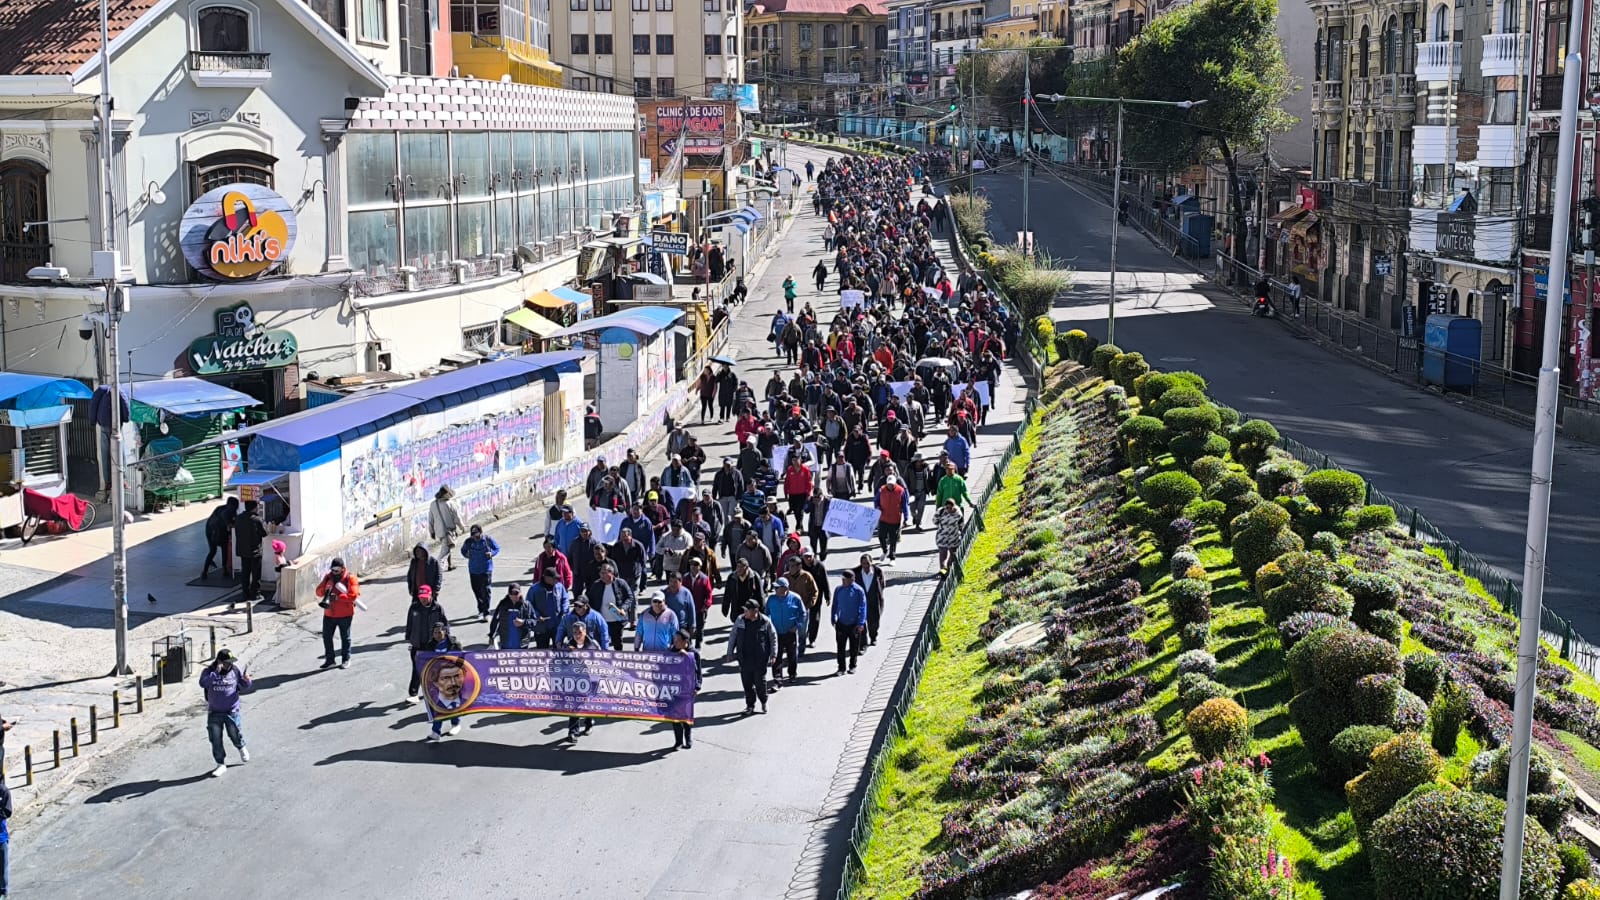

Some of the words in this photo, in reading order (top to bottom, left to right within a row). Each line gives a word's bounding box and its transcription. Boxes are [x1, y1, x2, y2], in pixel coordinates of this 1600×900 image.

[690, 107, 700, 117] DE
[703, 106, 723, 116] OJOS
[211, 229, 281, 264] niki's
[1437, 233, 1458, 250] MONTE
[1458, 235, 1474, 252] CARL
[474, 651, 547, 660] SINDICATO
[549, 651, 590, 659] MIXTO
[593, 651, 612, 659] DE
[614, 652, 682, 664] CHOFERES
[612, 660, 660, 671] MICROS
[489, 666, 561, 674] MINIBUSES
[636, 672, 681, 682] TRUFIS
